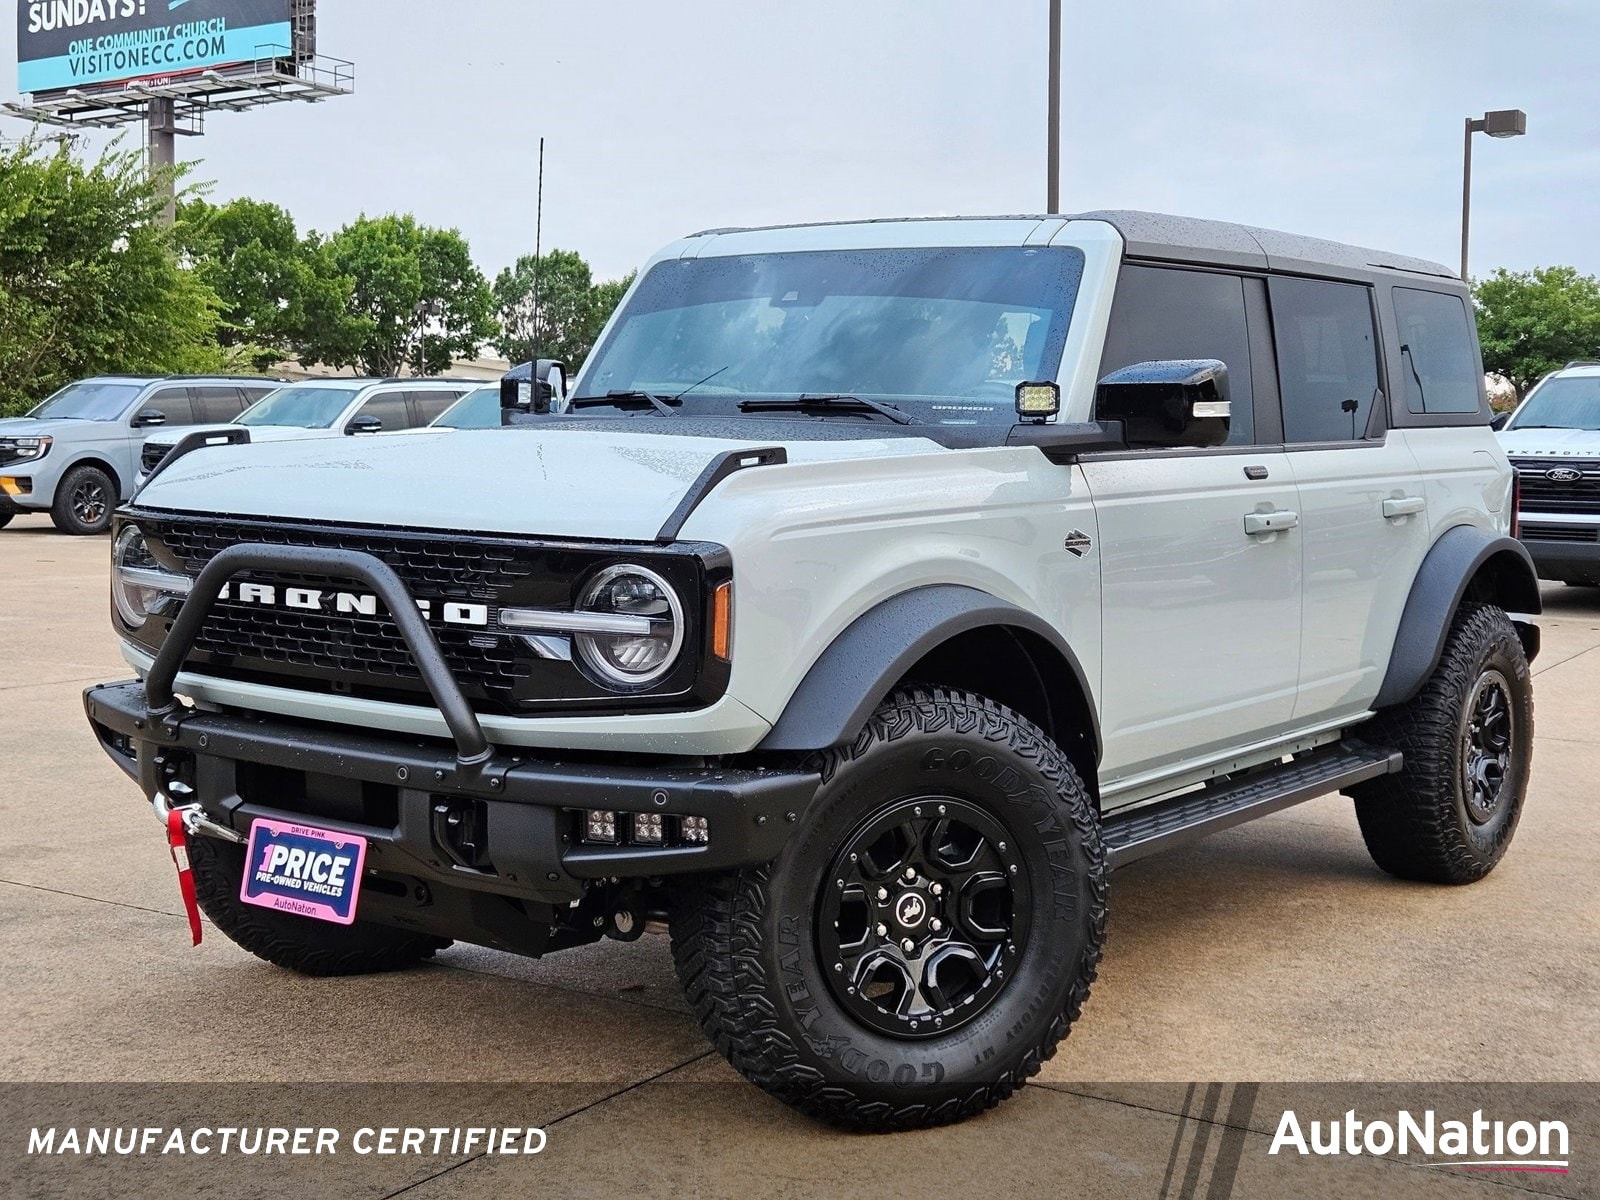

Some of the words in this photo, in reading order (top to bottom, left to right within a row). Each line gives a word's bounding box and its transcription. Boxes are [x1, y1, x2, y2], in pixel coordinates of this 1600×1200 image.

[68, 38, 94, 55] ONE
[96, 26, 171, 50] COMMUNITY
[173, 17, 226, 38] CHURCH
[69, 35, 225, 76] VISITONECC.COM
[291, 826, 310, 836] DRIVE
[310, 830, 326, 839] PINK
[255, 871, 302, 889] PRE-OWNED
[303, 880, 343, 897] VEHICLES
[273, 897, 318, 916] AutoNation
